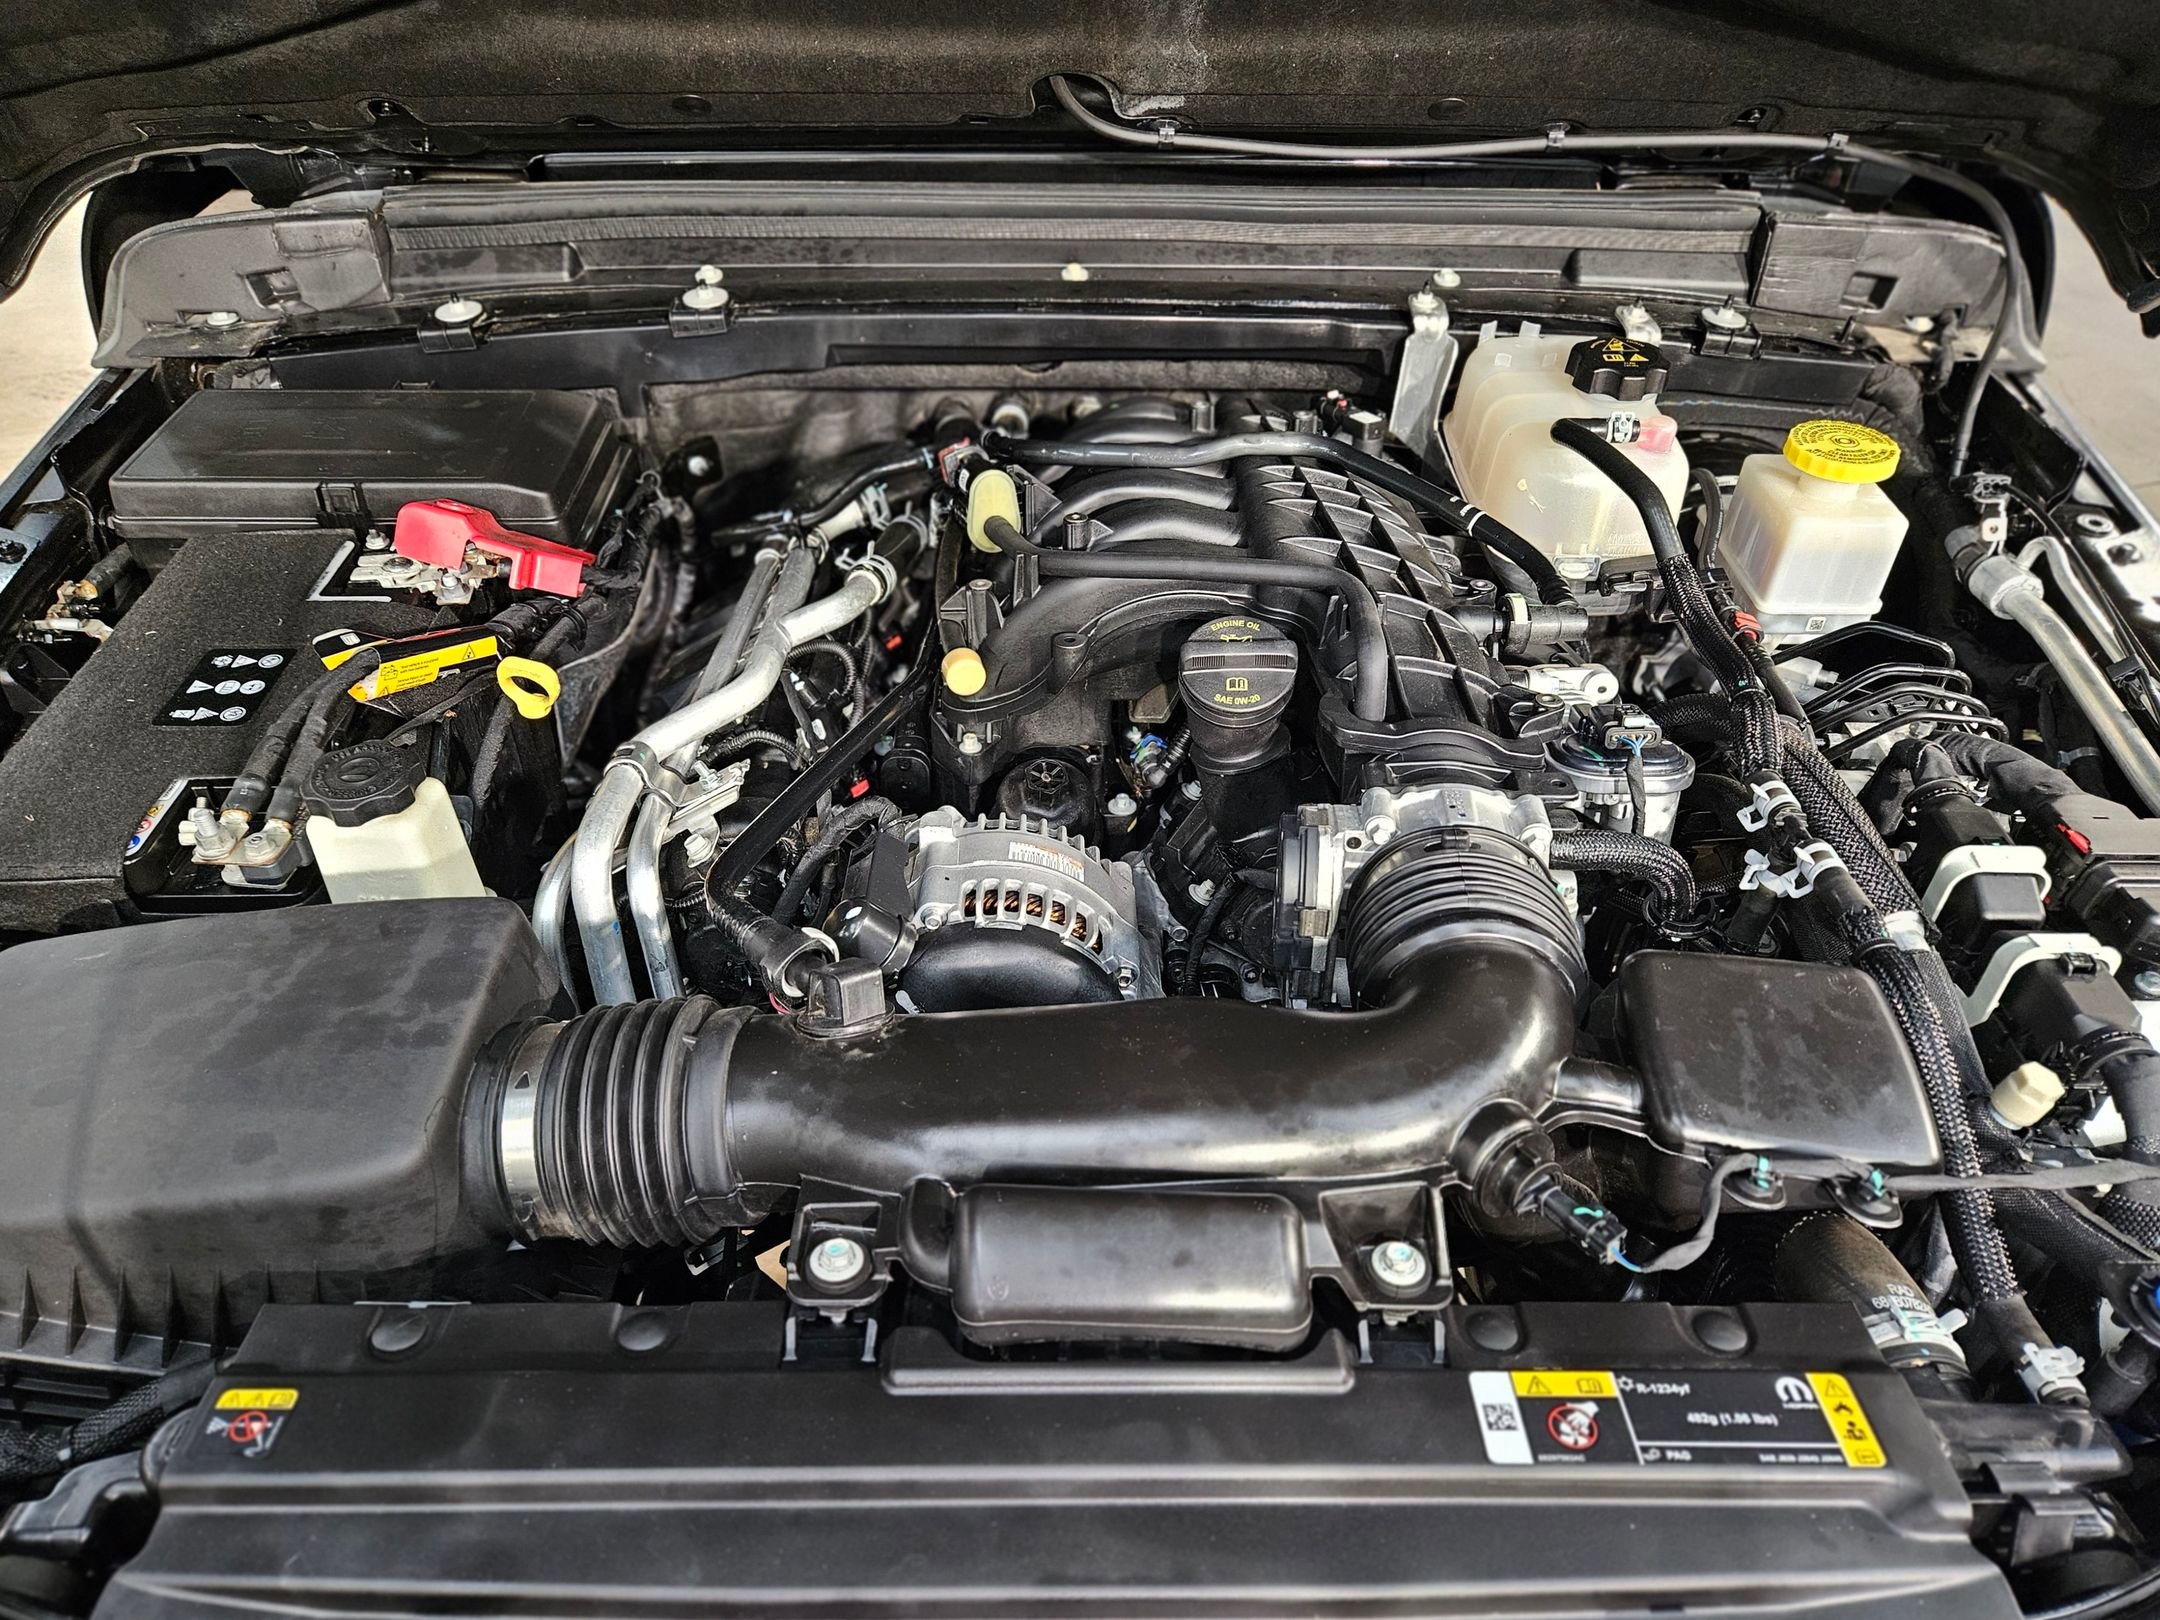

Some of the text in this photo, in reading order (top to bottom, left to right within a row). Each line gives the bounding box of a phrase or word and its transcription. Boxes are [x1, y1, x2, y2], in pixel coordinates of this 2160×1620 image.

[1210, 619, 1261, 632] ENGINE OIL
[1213, 693, 1234, 705] SAE
[1887, 1283, 1915, 1298] RAD
[1635, 1382, 1691, 1397] R-1234yf
